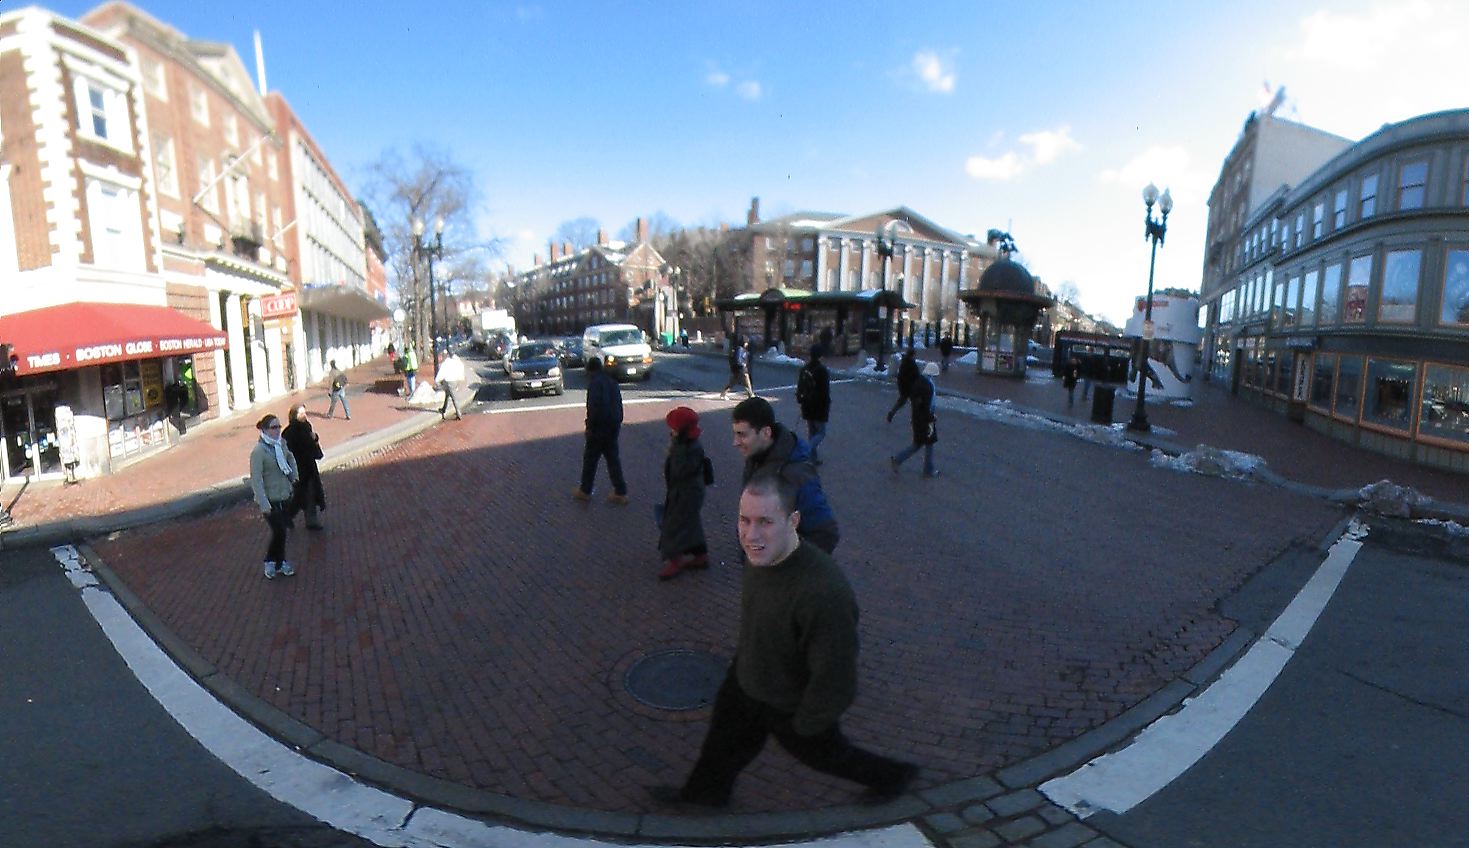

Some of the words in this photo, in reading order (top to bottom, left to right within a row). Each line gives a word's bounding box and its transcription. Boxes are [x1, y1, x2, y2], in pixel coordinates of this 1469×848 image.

[27, 352, 61, 369] TIMES
[75, 343, 123, 362] BOSTON
[125, 340, 153, 356] GLOBE
[159, 339, 182, 351] BOSTON
[183, 338, 203, 349] HERALD
